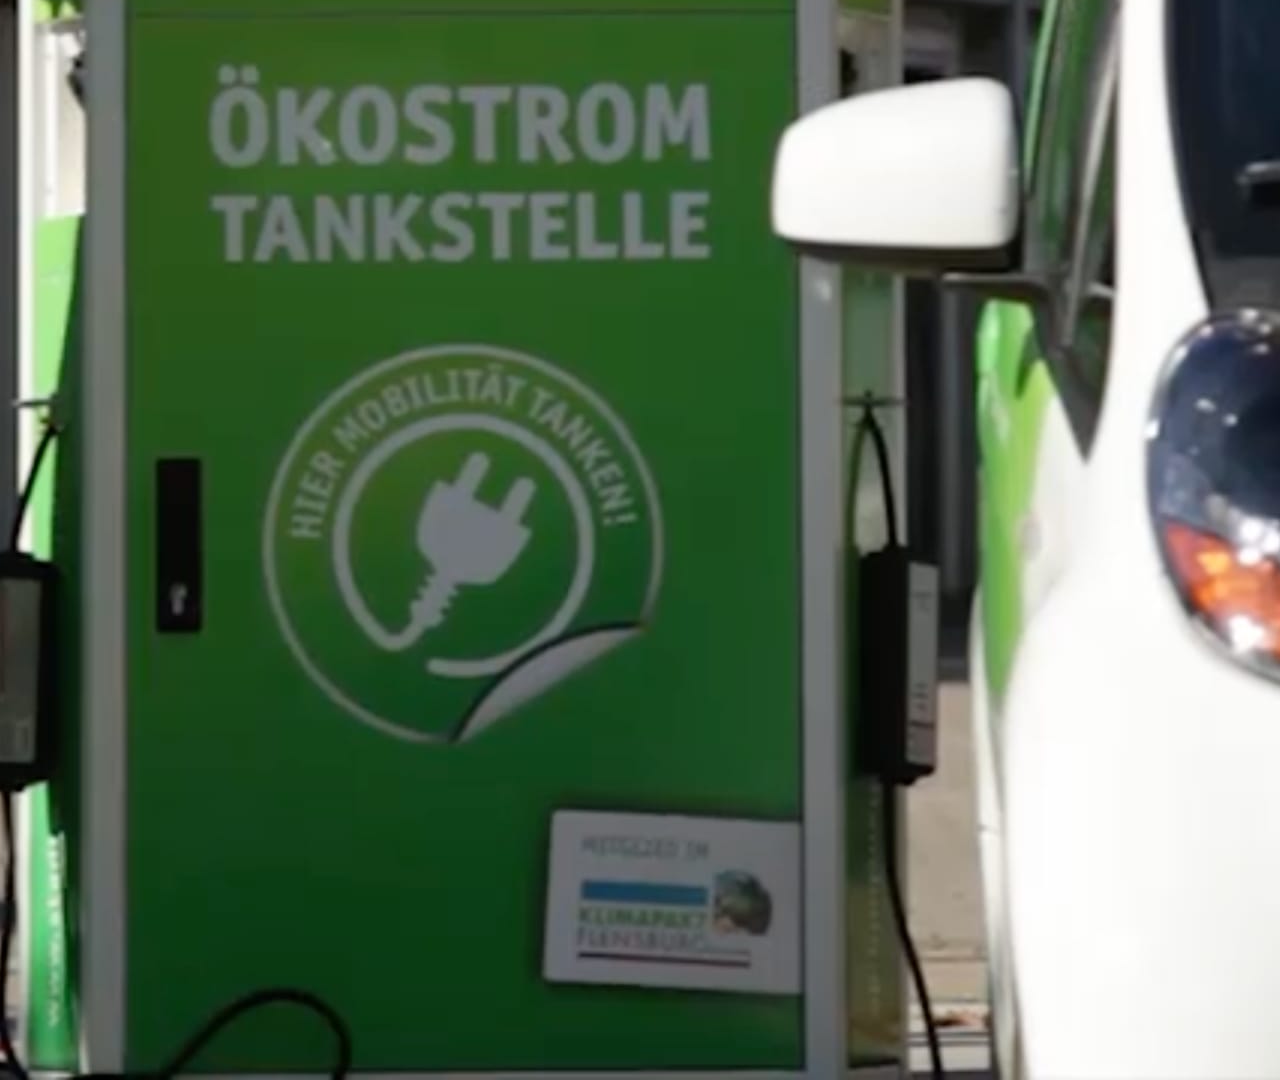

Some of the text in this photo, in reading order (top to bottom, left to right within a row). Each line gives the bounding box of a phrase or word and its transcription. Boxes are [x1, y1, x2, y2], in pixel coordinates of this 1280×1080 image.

[209, 64, 713, 167] ÖKOSTROM
[210, 191, 712, 262] TANKSTELLE
[291, 363, 638, 540] HIER MOBILITÄT TANKEN!
